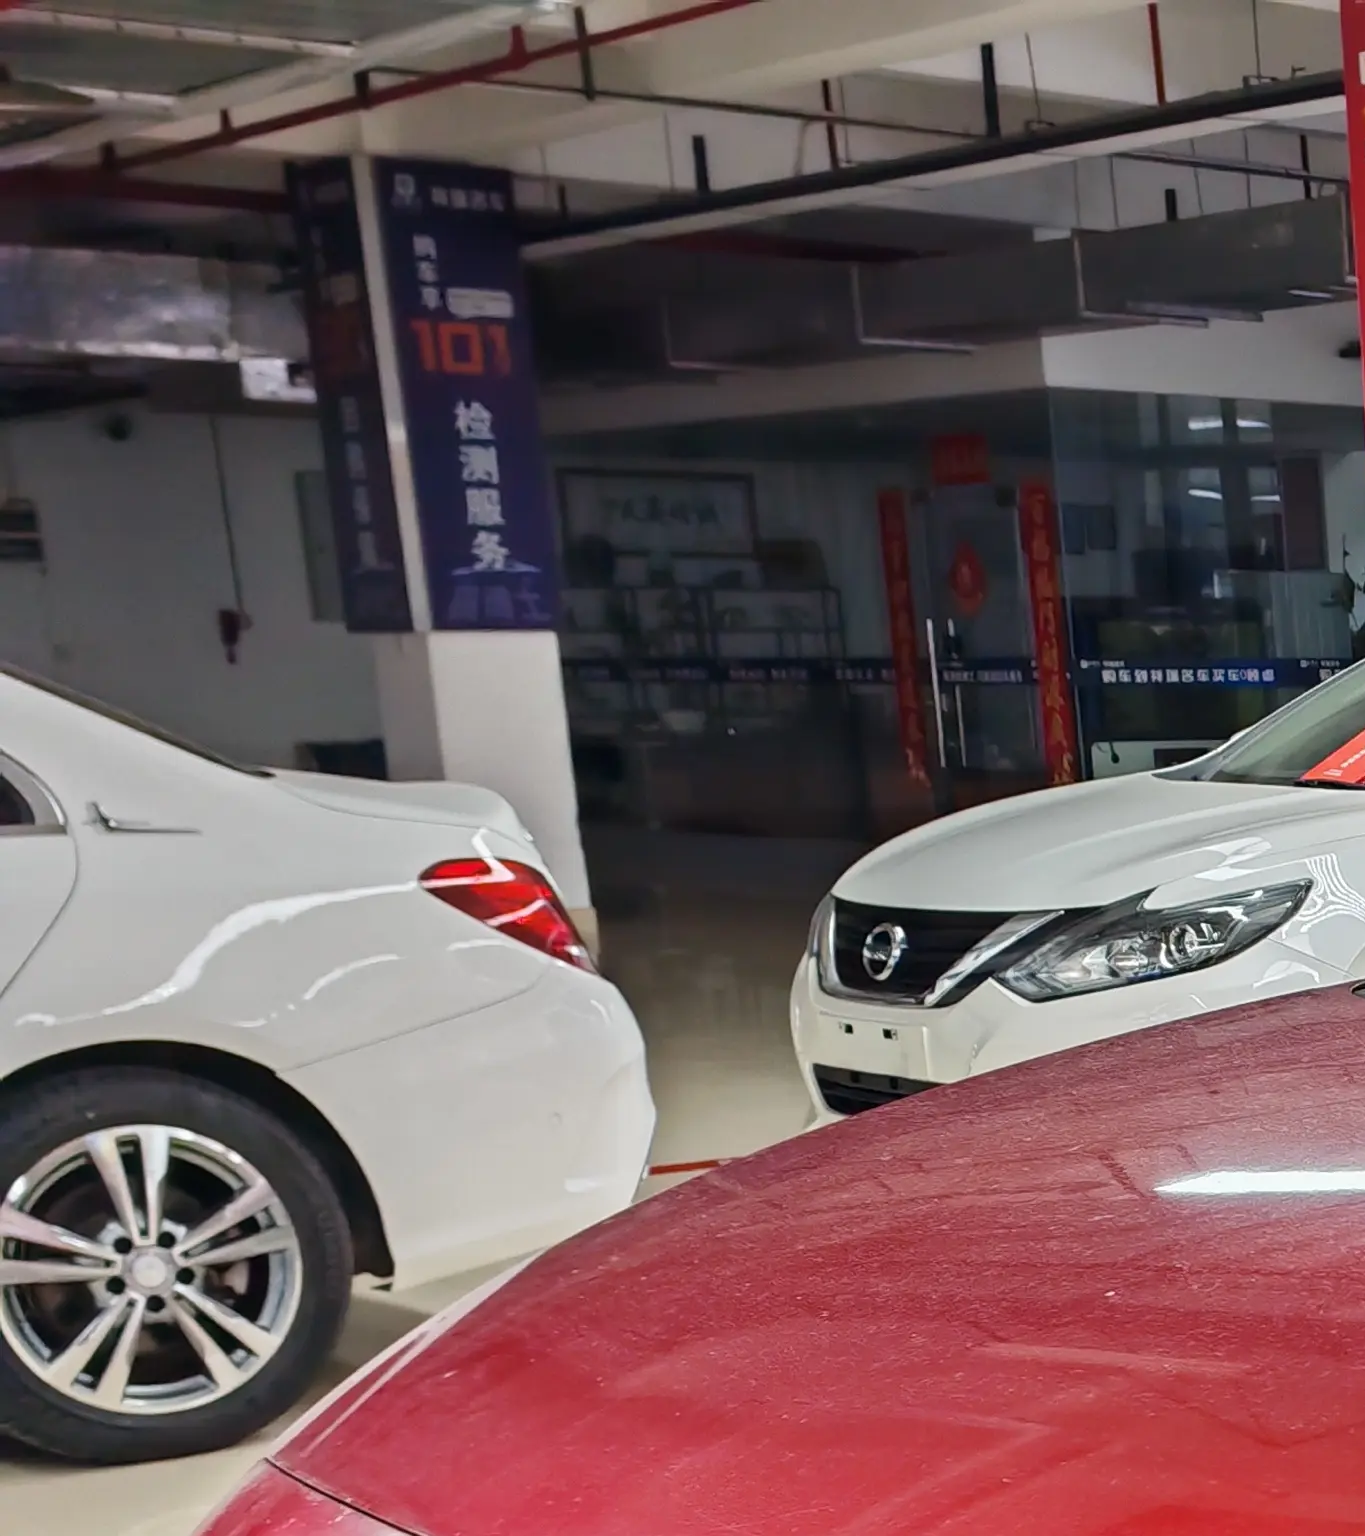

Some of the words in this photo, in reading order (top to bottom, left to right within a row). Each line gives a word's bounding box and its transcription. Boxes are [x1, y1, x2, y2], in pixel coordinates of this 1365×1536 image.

[411, 320, 512, 375] 101
[455, 399, 512, 572] 检测服务
